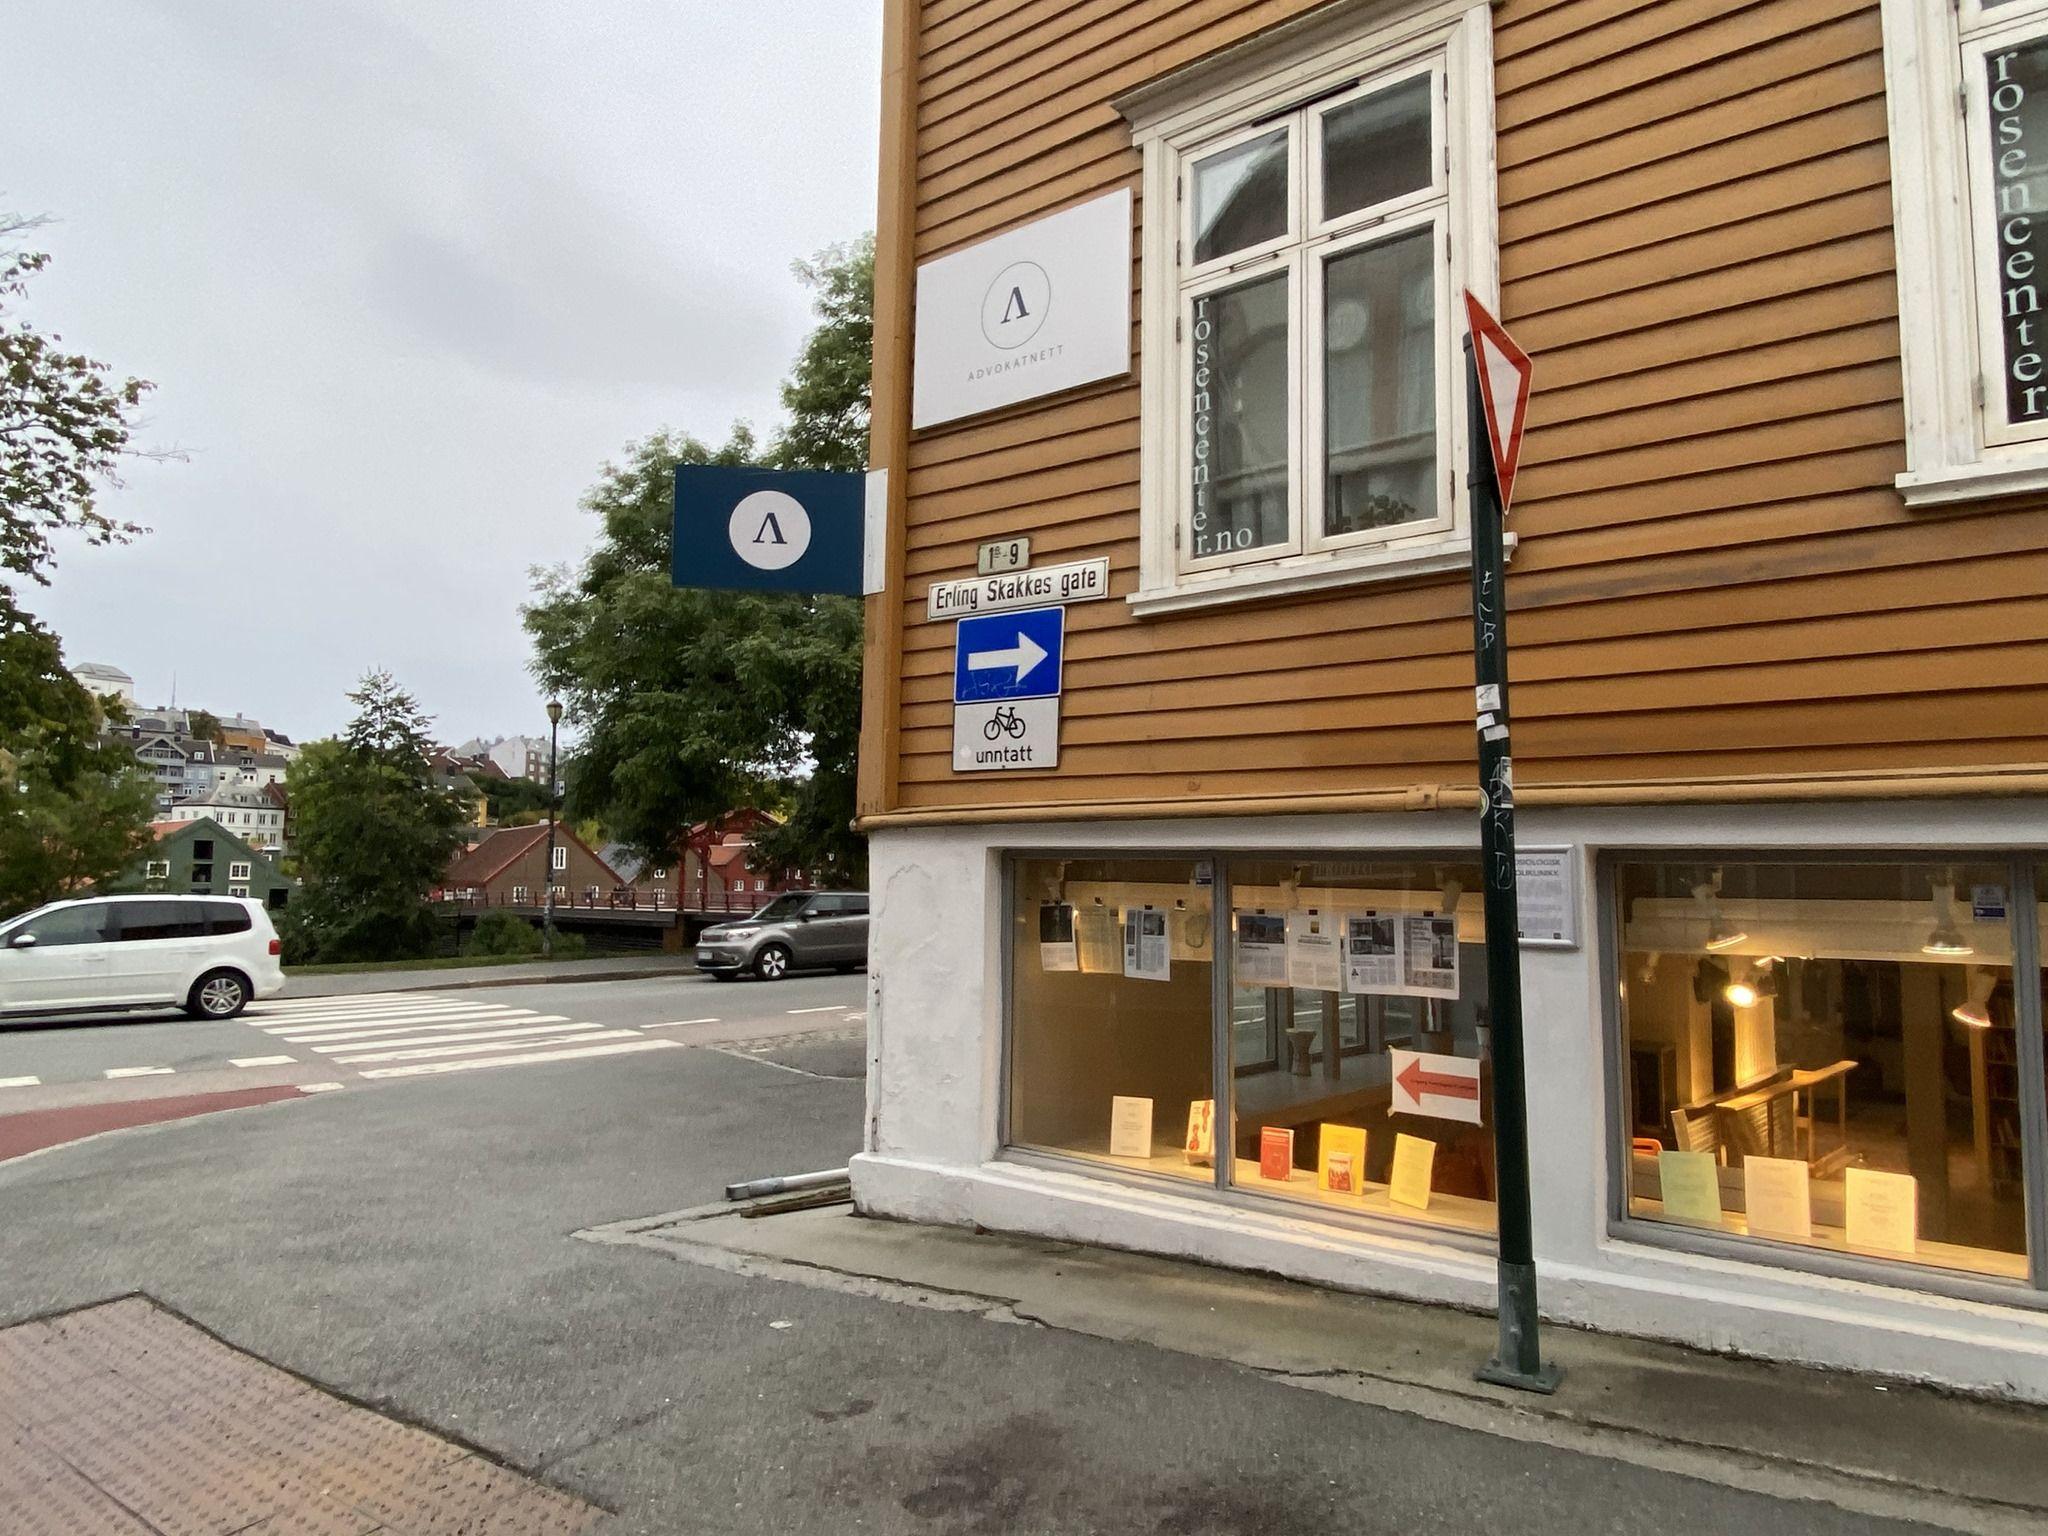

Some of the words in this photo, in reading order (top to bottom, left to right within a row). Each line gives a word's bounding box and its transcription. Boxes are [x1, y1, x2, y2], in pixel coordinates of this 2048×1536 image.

[967, 344, 1063, 381] ADVOKATNETT
[936, 585, 978, 610] Erling
[986, 575, 1051, 602] Skakkes
[1061, 567, 1096, 597] gate
[975, 745, 1033, 763] unntatt
